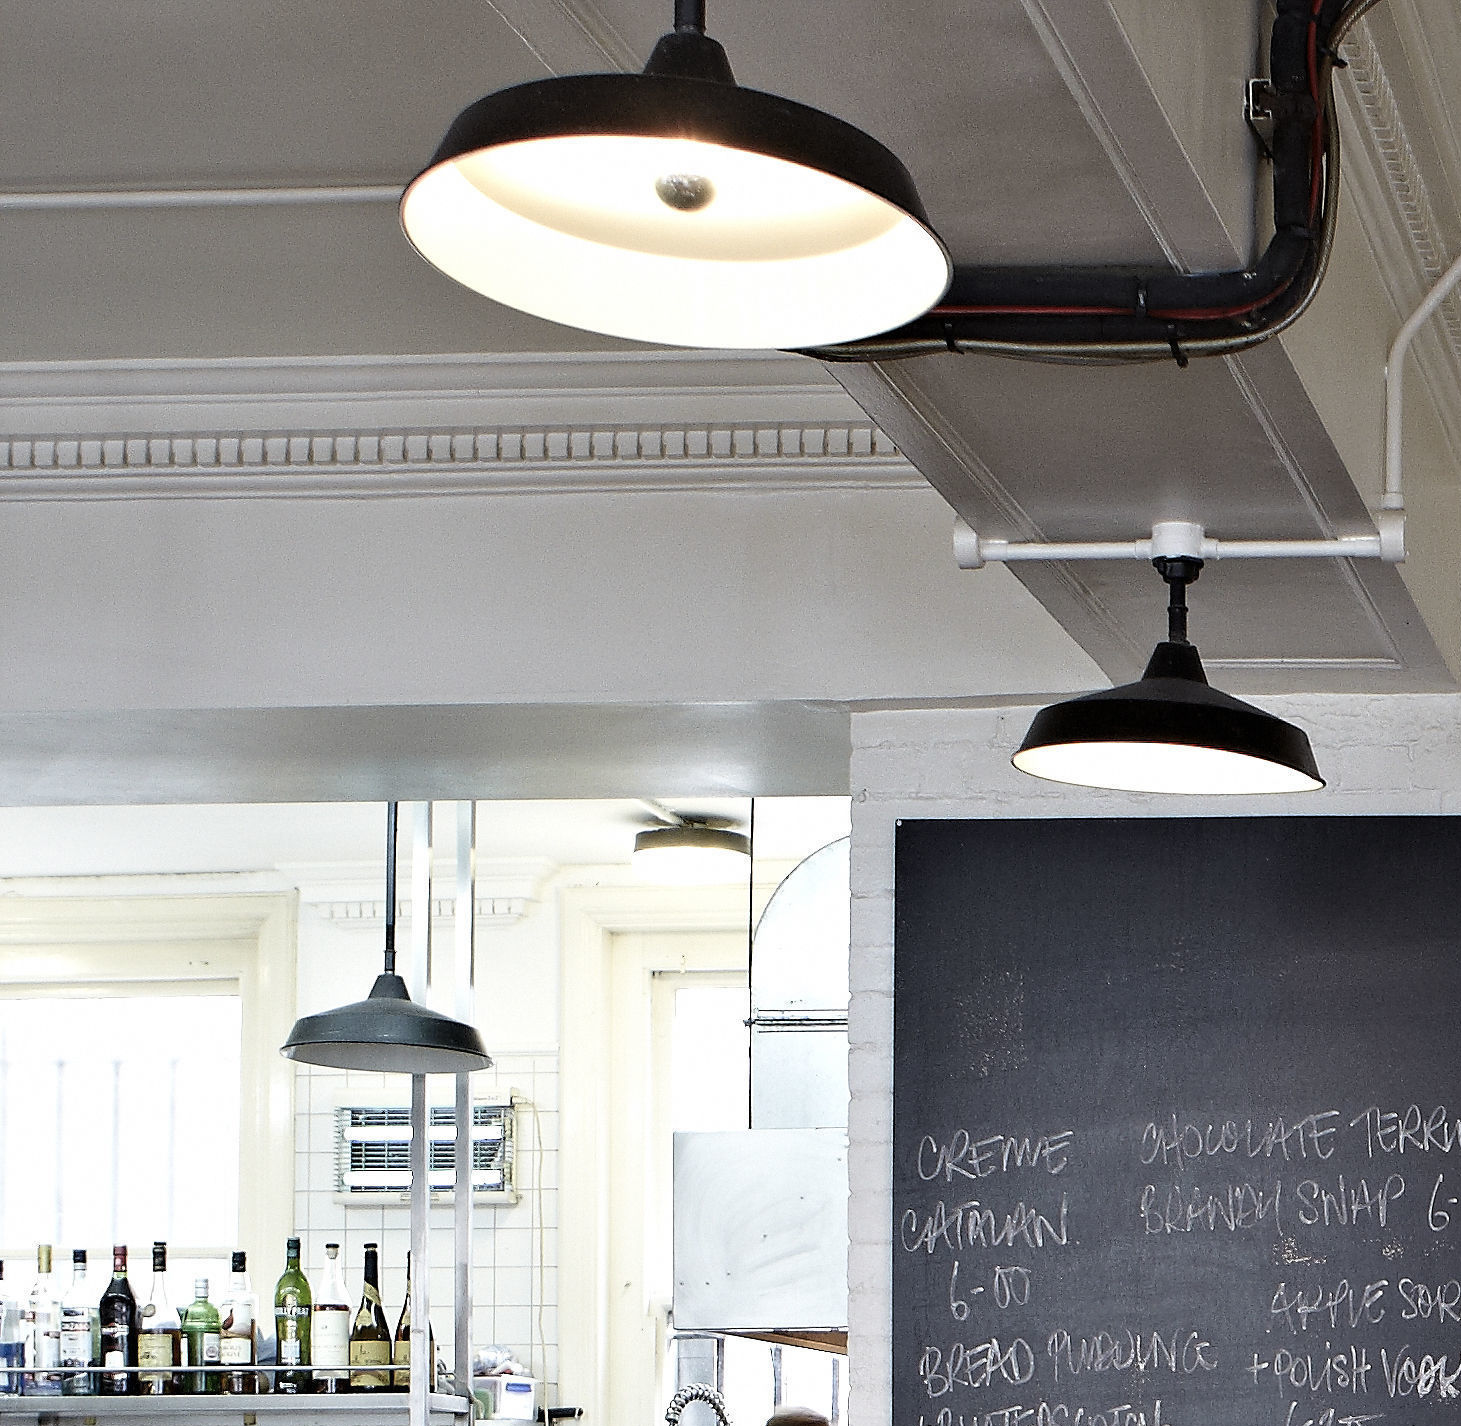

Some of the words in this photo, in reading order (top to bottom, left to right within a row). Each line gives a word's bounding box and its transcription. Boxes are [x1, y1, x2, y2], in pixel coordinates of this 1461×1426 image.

[917, 1129, 1074, 1182] CREME
[1140, 1110, 1340, 1170] CHOCOLATE
[1140, 1180, 1284, 1236] BRANDY
[1297, 1174, 1405, 1228] SNAP
[1271, 1279, 1389, 1333] APPLE
[919, 1338, 1035, 1398] BREAD
[1048, 1328, 1218, 1382] PUDDING
